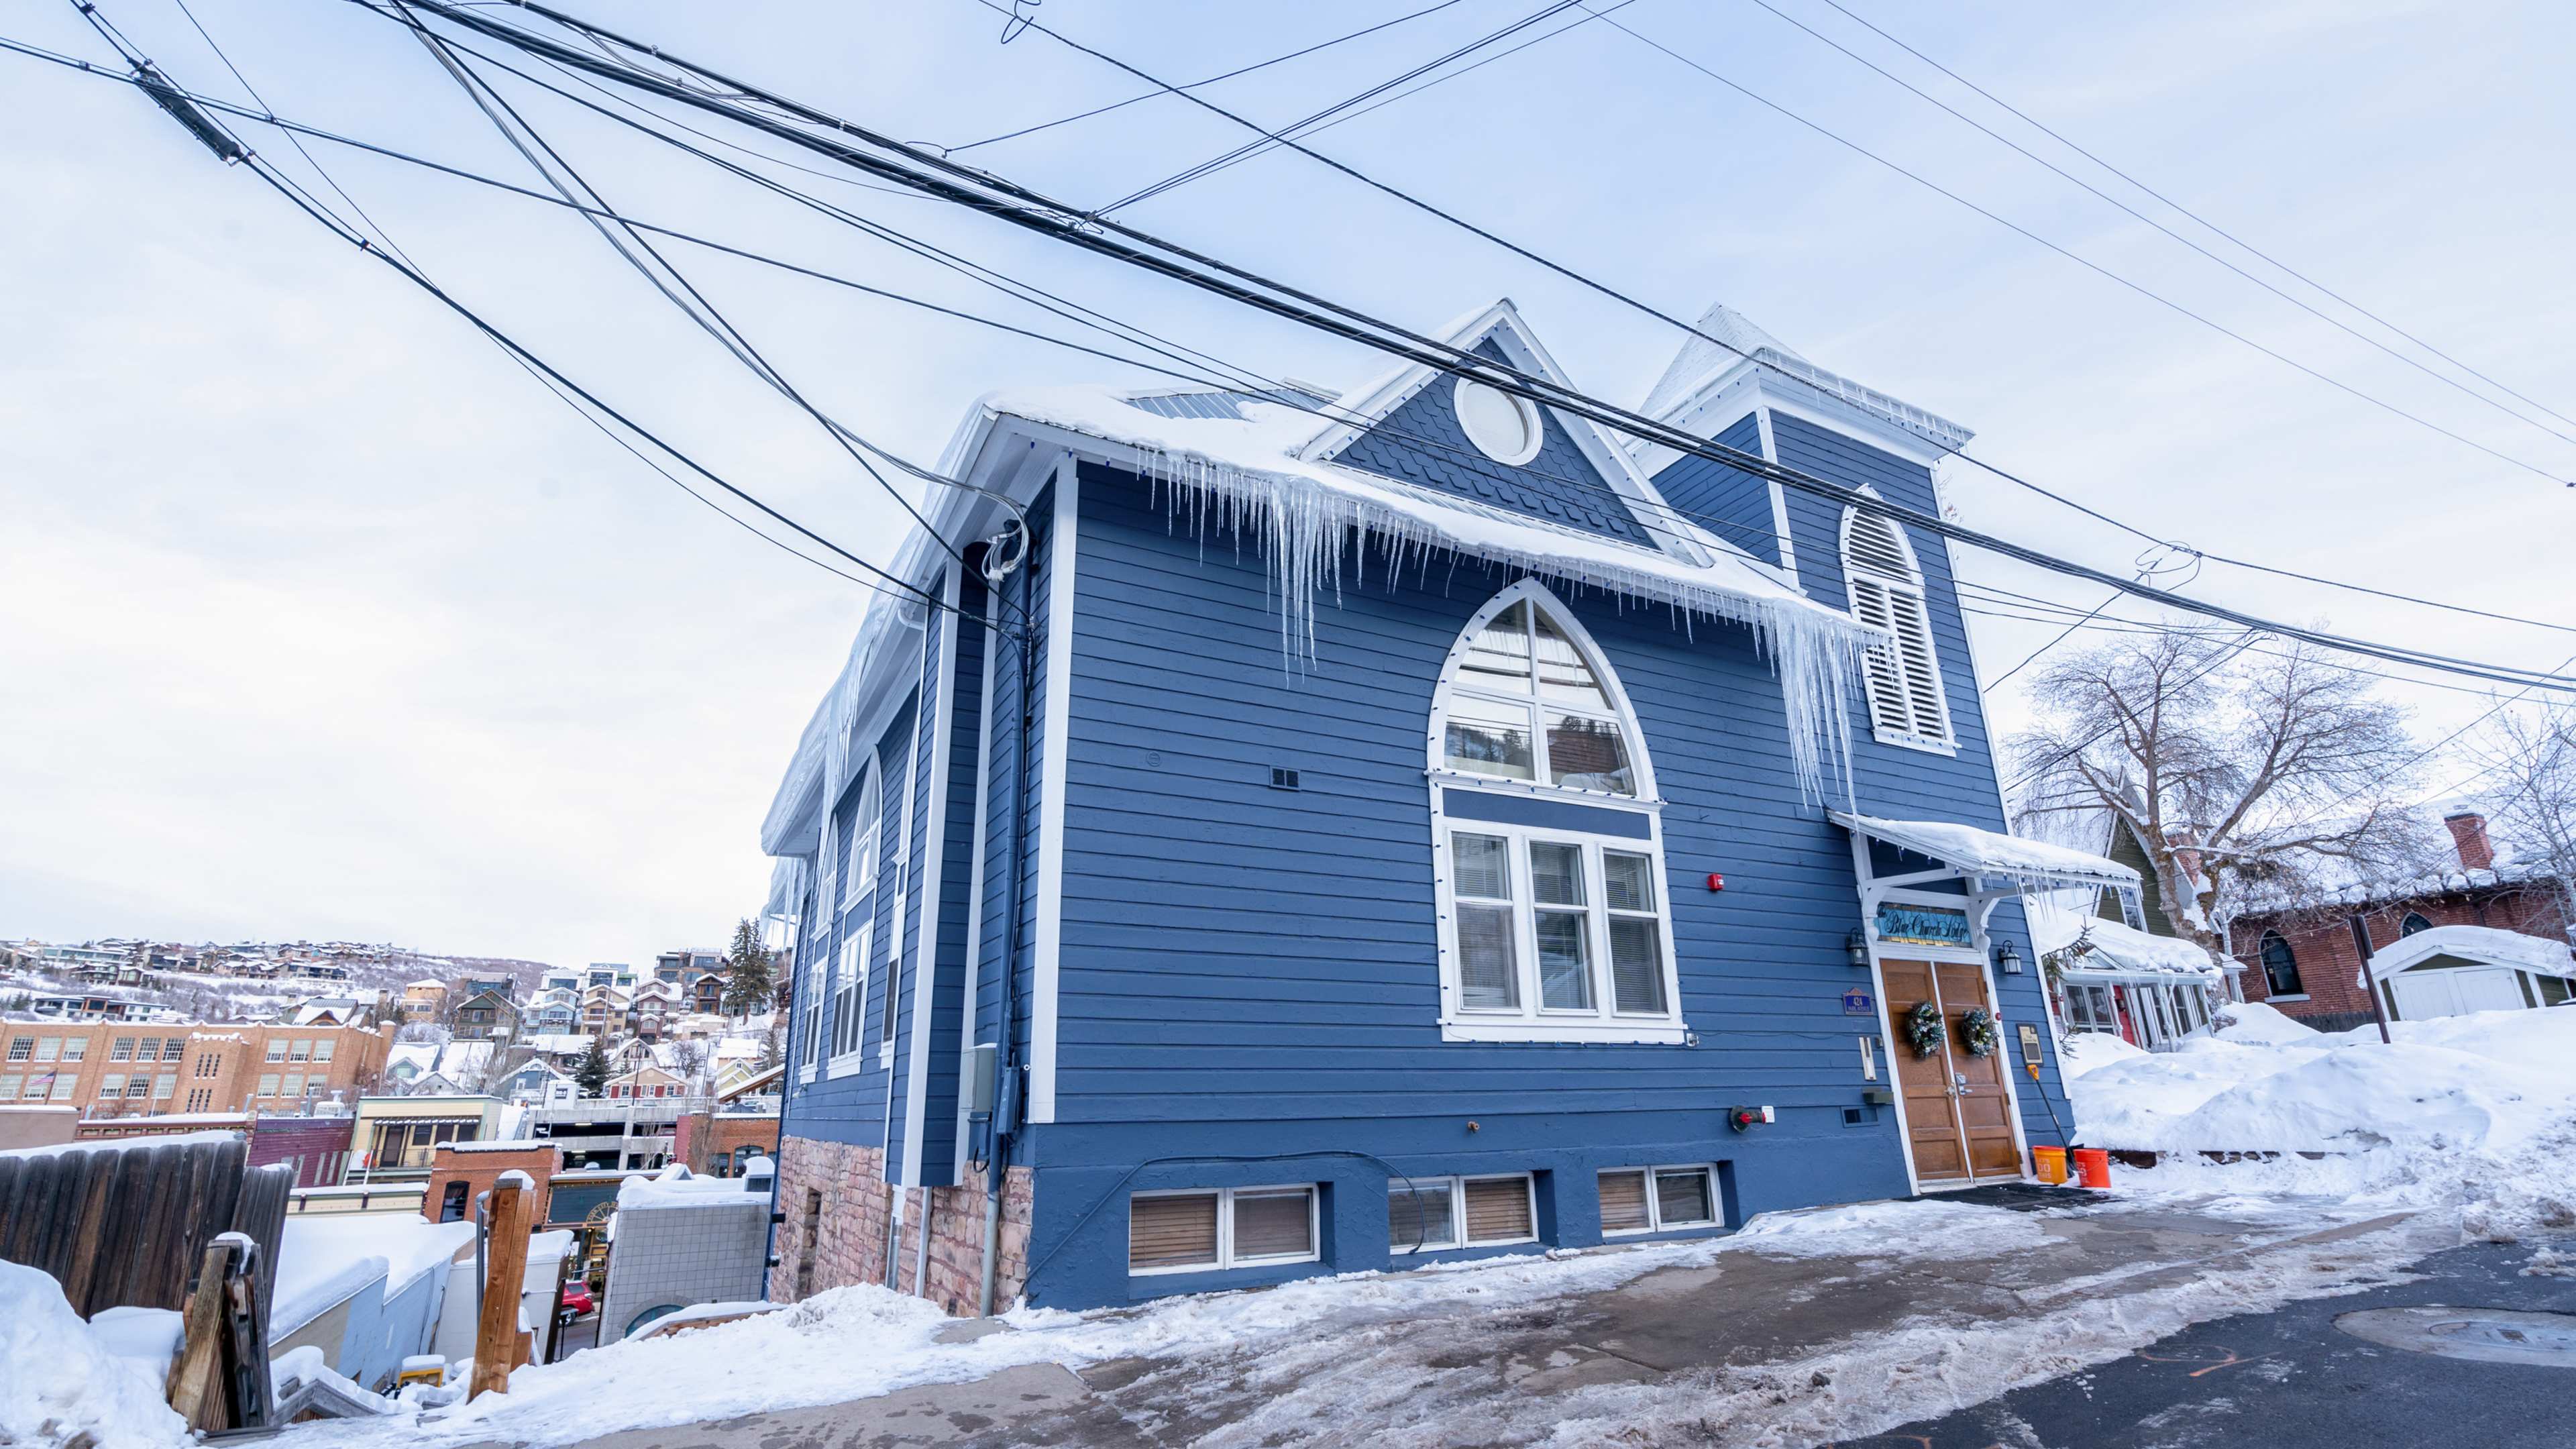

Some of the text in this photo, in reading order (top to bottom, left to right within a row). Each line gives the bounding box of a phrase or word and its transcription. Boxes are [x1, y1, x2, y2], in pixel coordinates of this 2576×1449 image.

[1886, 912, 1909, 934] Blue
[1912, 914, 1941, 936] Church
[1942, 914, 1970, 942] Lodge
[1853, 997, 1862, 1006] 424
